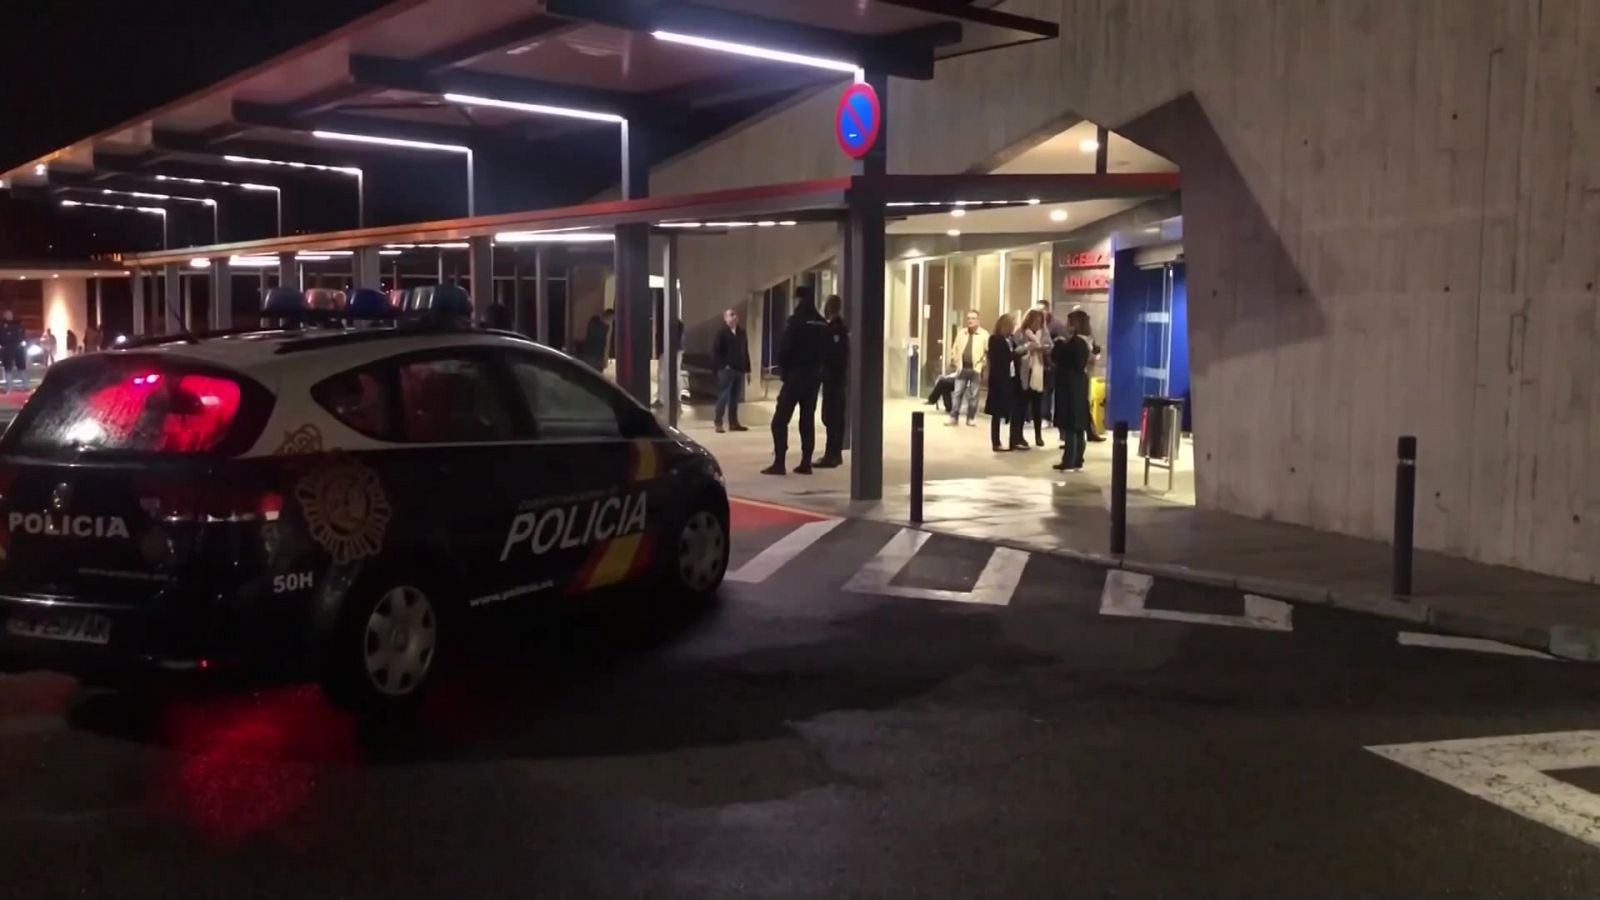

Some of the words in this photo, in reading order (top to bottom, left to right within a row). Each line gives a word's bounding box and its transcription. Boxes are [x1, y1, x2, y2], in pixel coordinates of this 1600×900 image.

[8, 511, 130, 540] POLICIA
[499, 490, 648, 562] POLICIA
[272, 570, 314, 594] 50H
